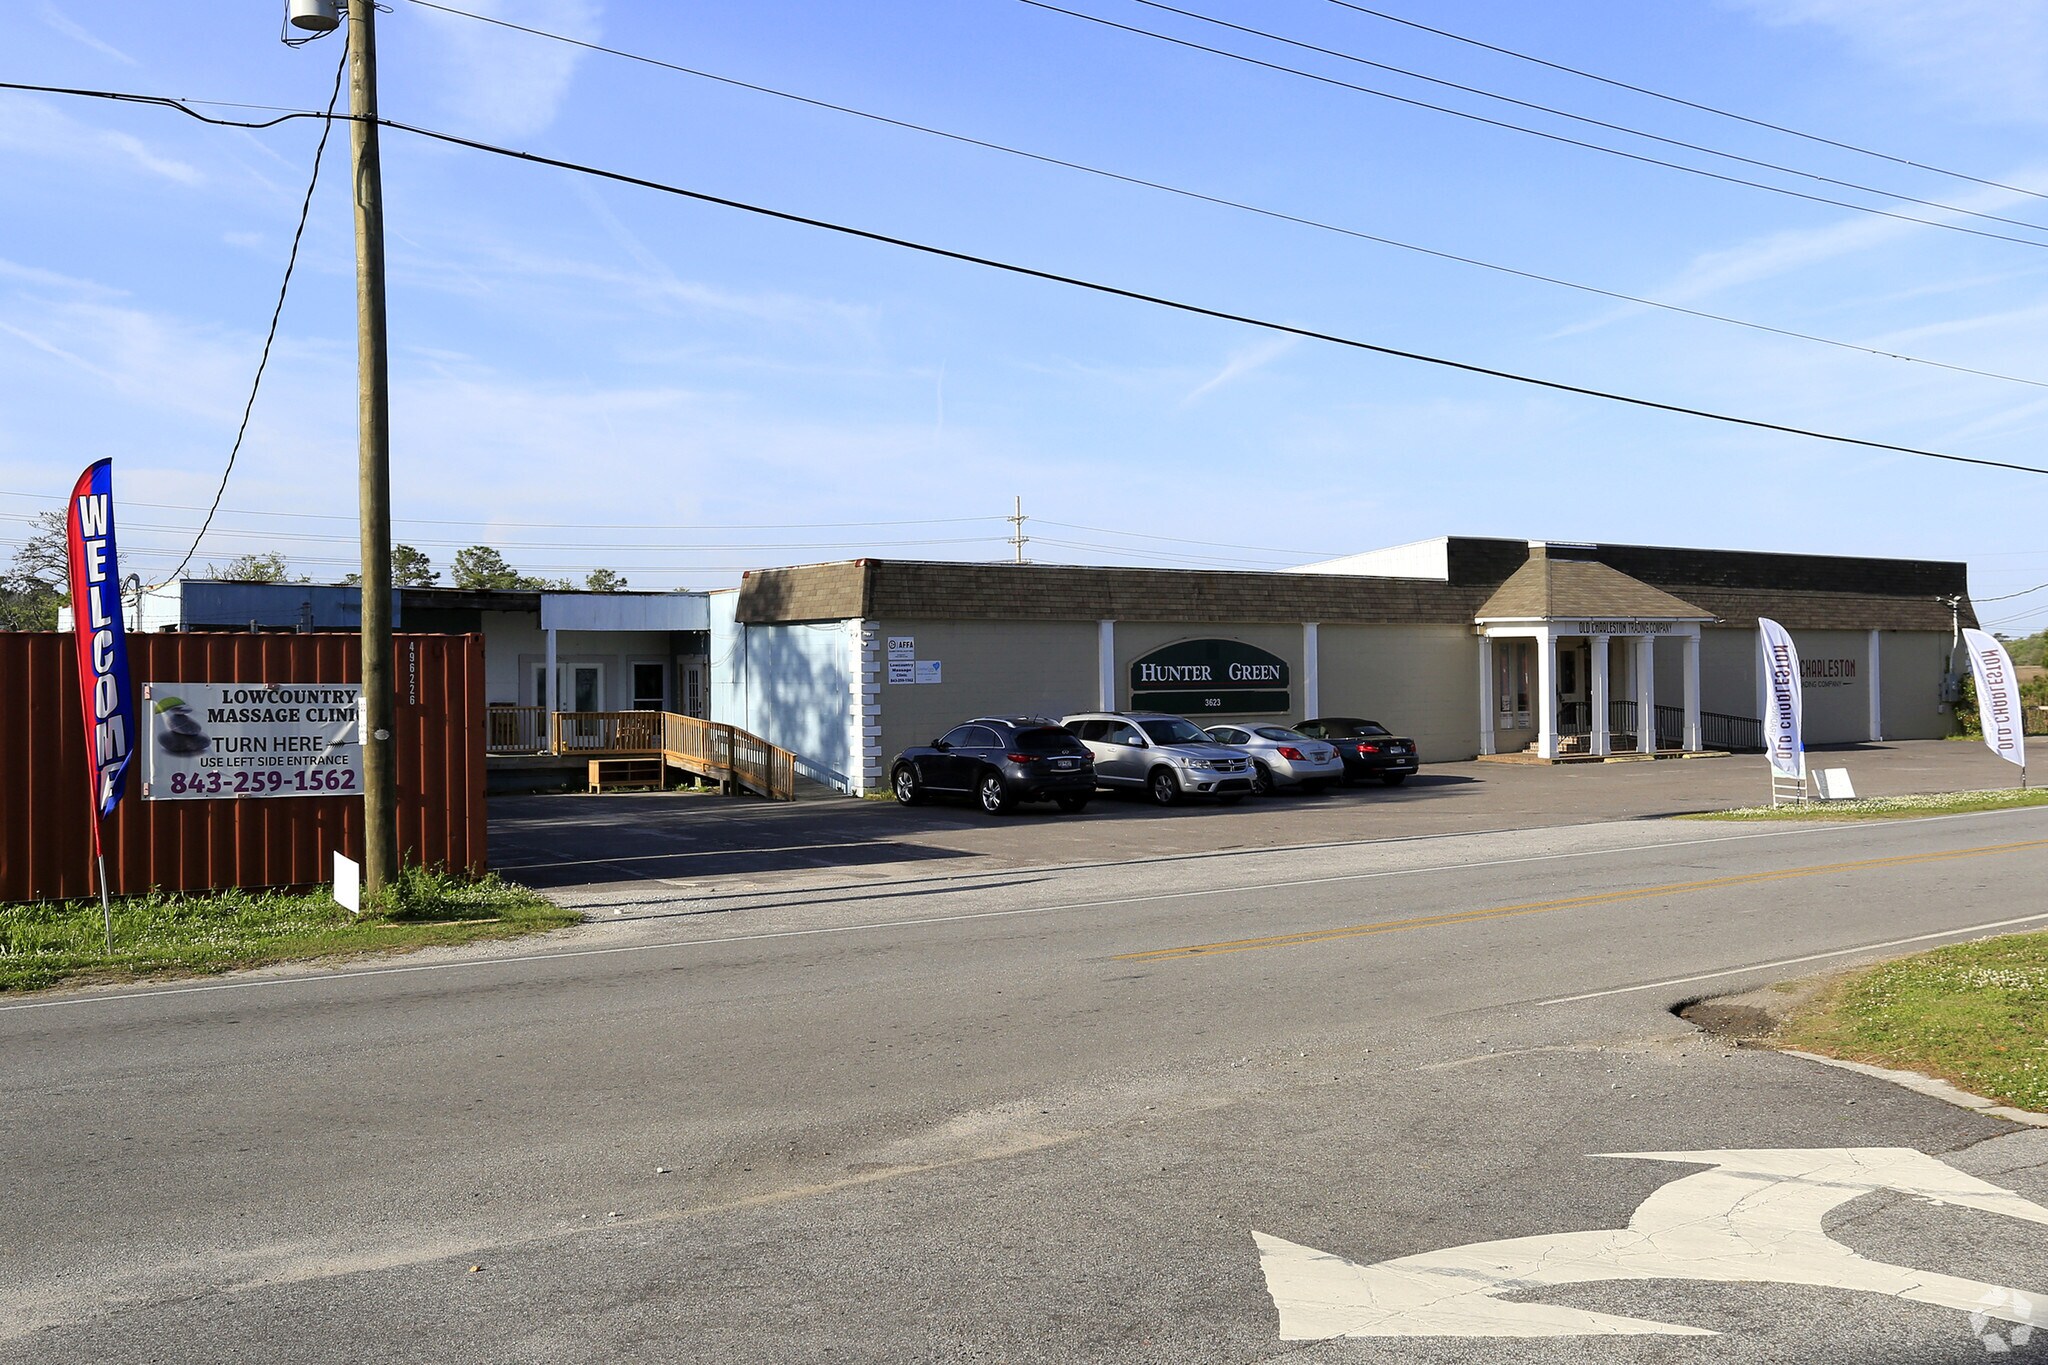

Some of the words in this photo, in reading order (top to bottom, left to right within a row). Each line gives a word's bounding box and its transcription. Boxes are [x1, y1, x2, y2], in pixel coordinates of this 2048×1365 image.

[1579, 622, 1590, 633] OLD
[1628, 622, 1648, 634] TRADING
[1649, 622, 1671, 634] COMPANY
[408, 641, 416, 706] 496226
[1800, 659, 1856, 677] CHARLESTON
[222, 689, 357, 704] LOWCOUNTRY
[1204, 699, 1221, 707] 3623
[207, 708, 300, 723] MASSAGE
[212, 736, 267, 753] TURN
[273, 736, 323, 752] HERE
[200, 757, 224, 768] USE
[226, 756, 254, 768] LEFT
[257, 756, 284, 767] SIDE
[287, 755, 349, 767] ENTRANCE
[170, 769, 356, 794] 843-259-1562
